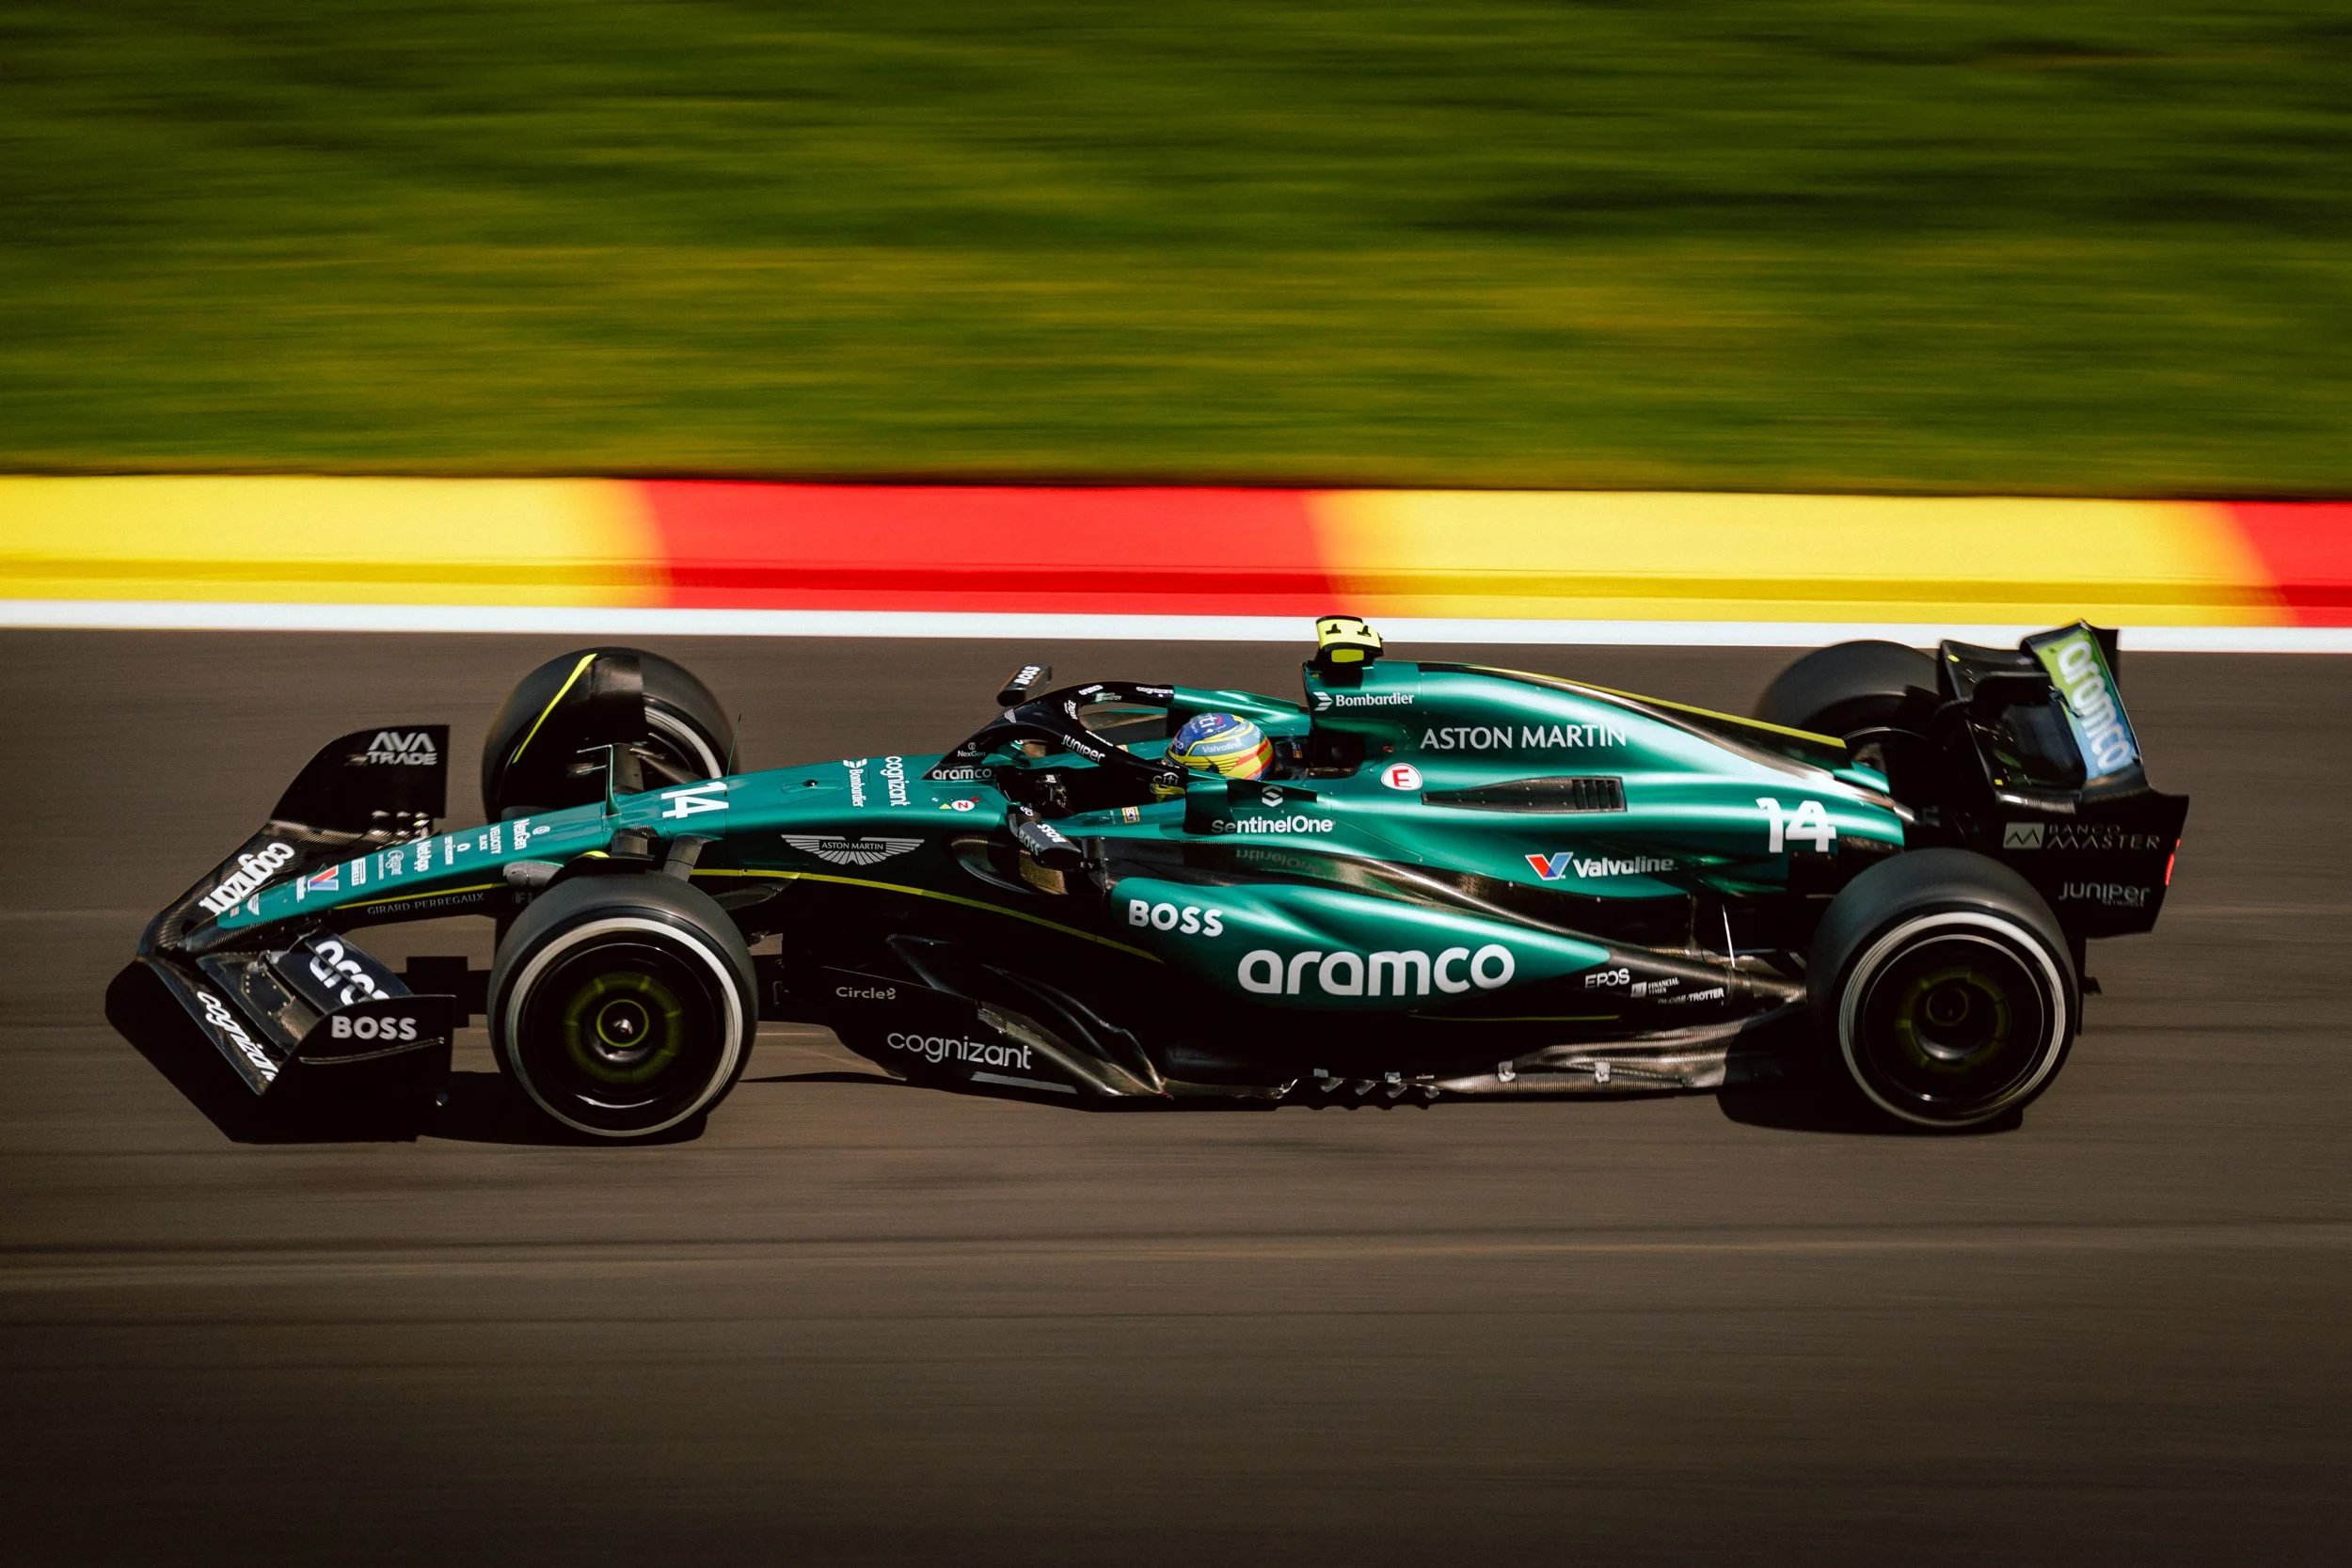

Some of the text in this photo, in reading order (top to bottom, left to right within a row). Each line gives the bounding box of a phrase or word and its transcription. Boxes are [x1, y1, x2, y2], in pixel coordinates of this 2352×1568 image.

[1014, 665, 1041, 686] BOSS
[1335, 692, 1415, 707] Bombardier
[2058, 641, 2130, 769] aramco
[368, 731, 437, 752] AVA
[1420, 723, 1628, 750] ASTON MARTIN
[366, 751, 438, 766] TRADE
[880, 755, 911, 806] cognizant
[931, 768, 993, 781] aramco
[1152, 771, 1180, 785] citi
[1392, 768, 1412, 787] E
[849, 768, 867, 808] Bombardier
[660, 781, 730, 819] 14
[513, 818, 531, 851] NexGen
[1037, 822, 1067, 844] BOSS
[1211, 815, 1334, 834] SentinelOne
[1755, 797, 1837, 853] 14
[821, 841, 884, 850] ASTON MARTIN
[1572, 856, 1675, 879] Valvoline
[1129, 899, 1224, 937] BOSS
[1237, 943, 1516, 997] aramco
[1584, 967, 1630, 989] EPOS
[1648, 976, 1680, 989] FINANCIAL
[331, 1015, 418, 1040] BOSS
[886, 1033, 1032, 1069] cognizant
